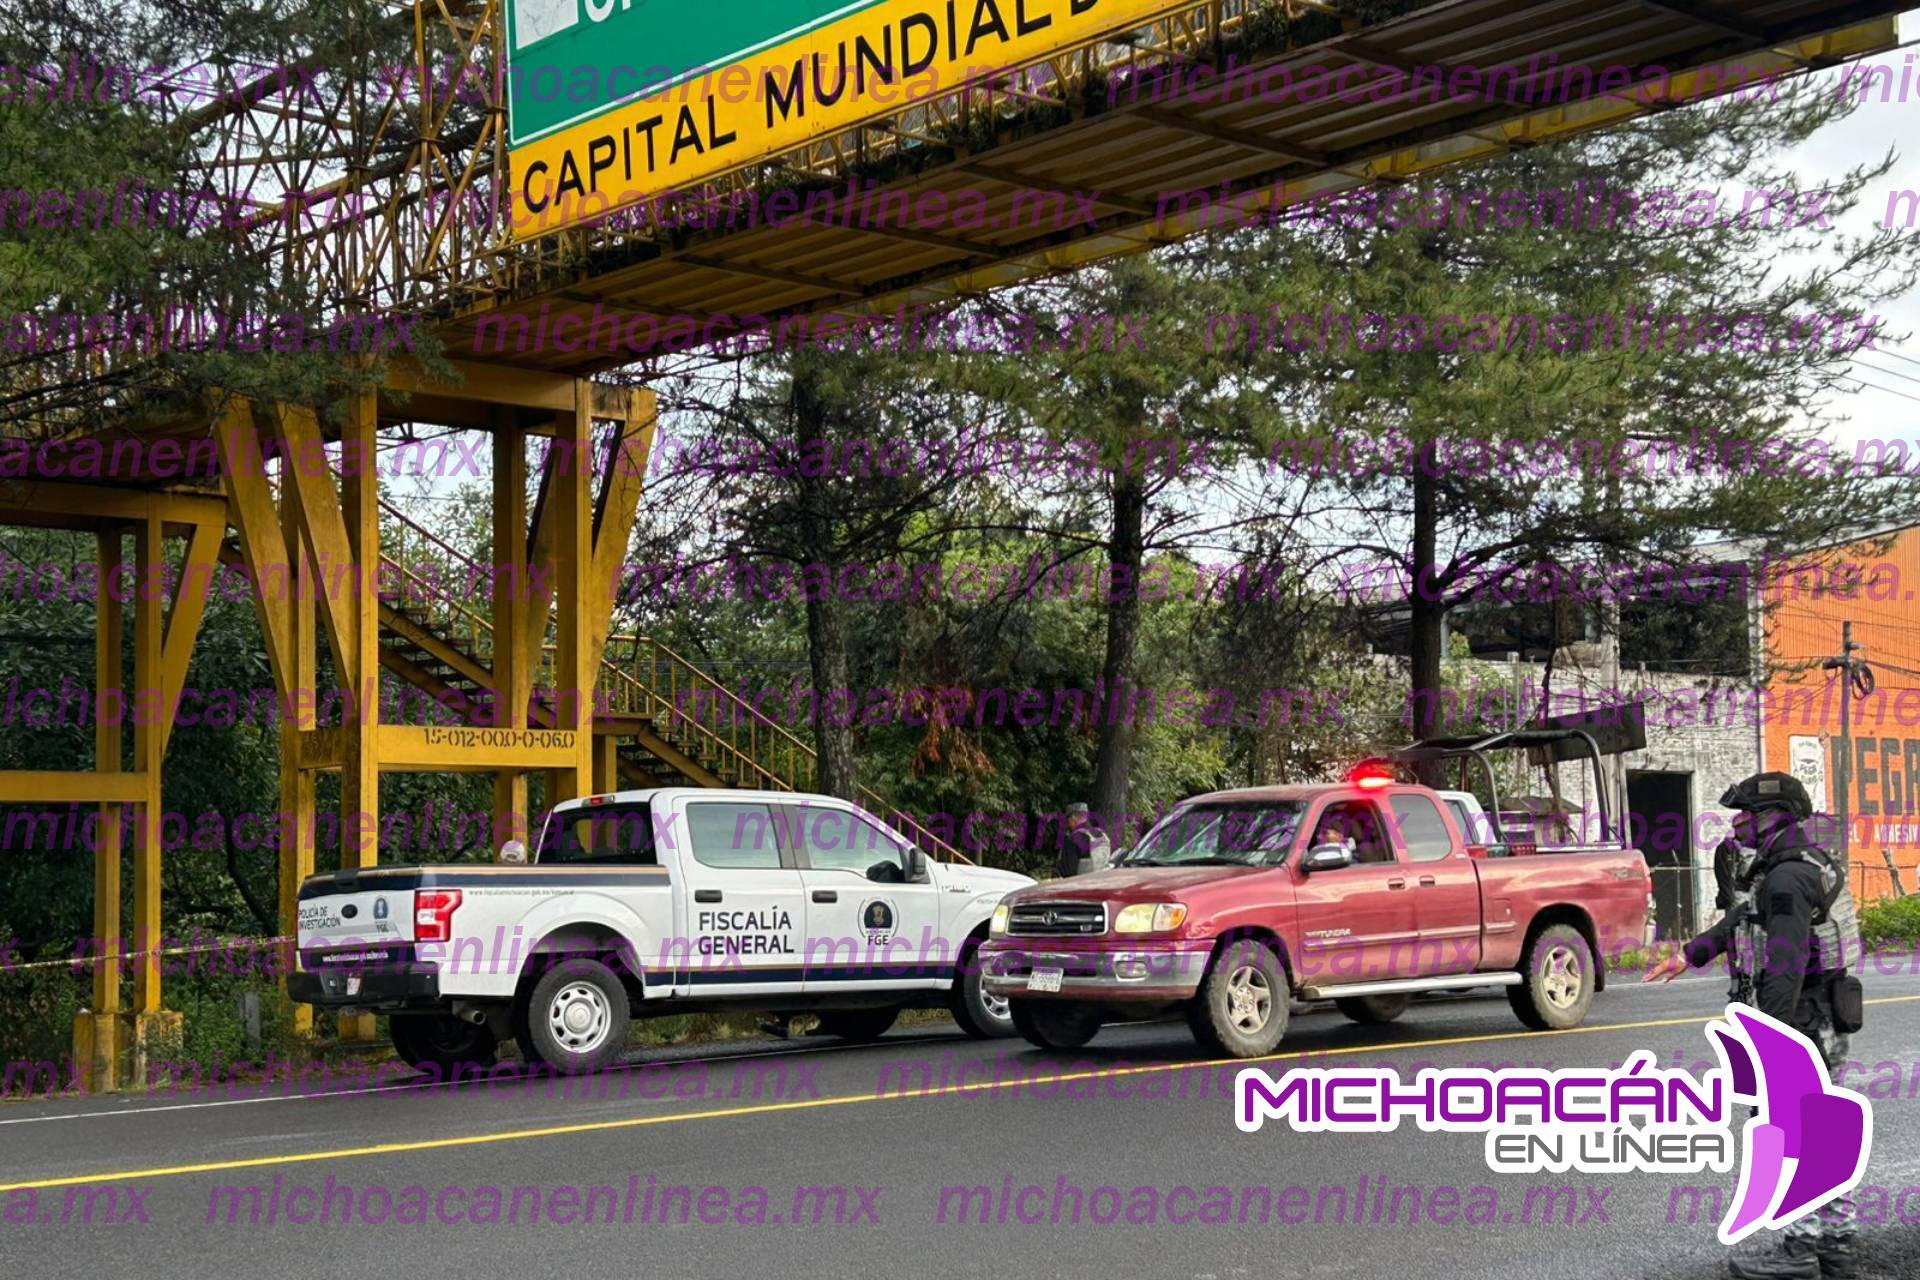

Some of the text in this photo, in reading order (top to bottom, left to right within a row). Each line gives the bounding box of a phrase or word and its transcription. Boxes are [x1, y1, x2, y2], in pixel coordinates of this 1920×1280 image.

[522, 0, 1052, 213] CAPITAL MUNDIAL
[319, 905, 328, 917] DE
[698, 905, 792, 933] FISCALÍA
[698, 931, 795, 956] GENERAL
[867, 935, 889, 946] FGE
